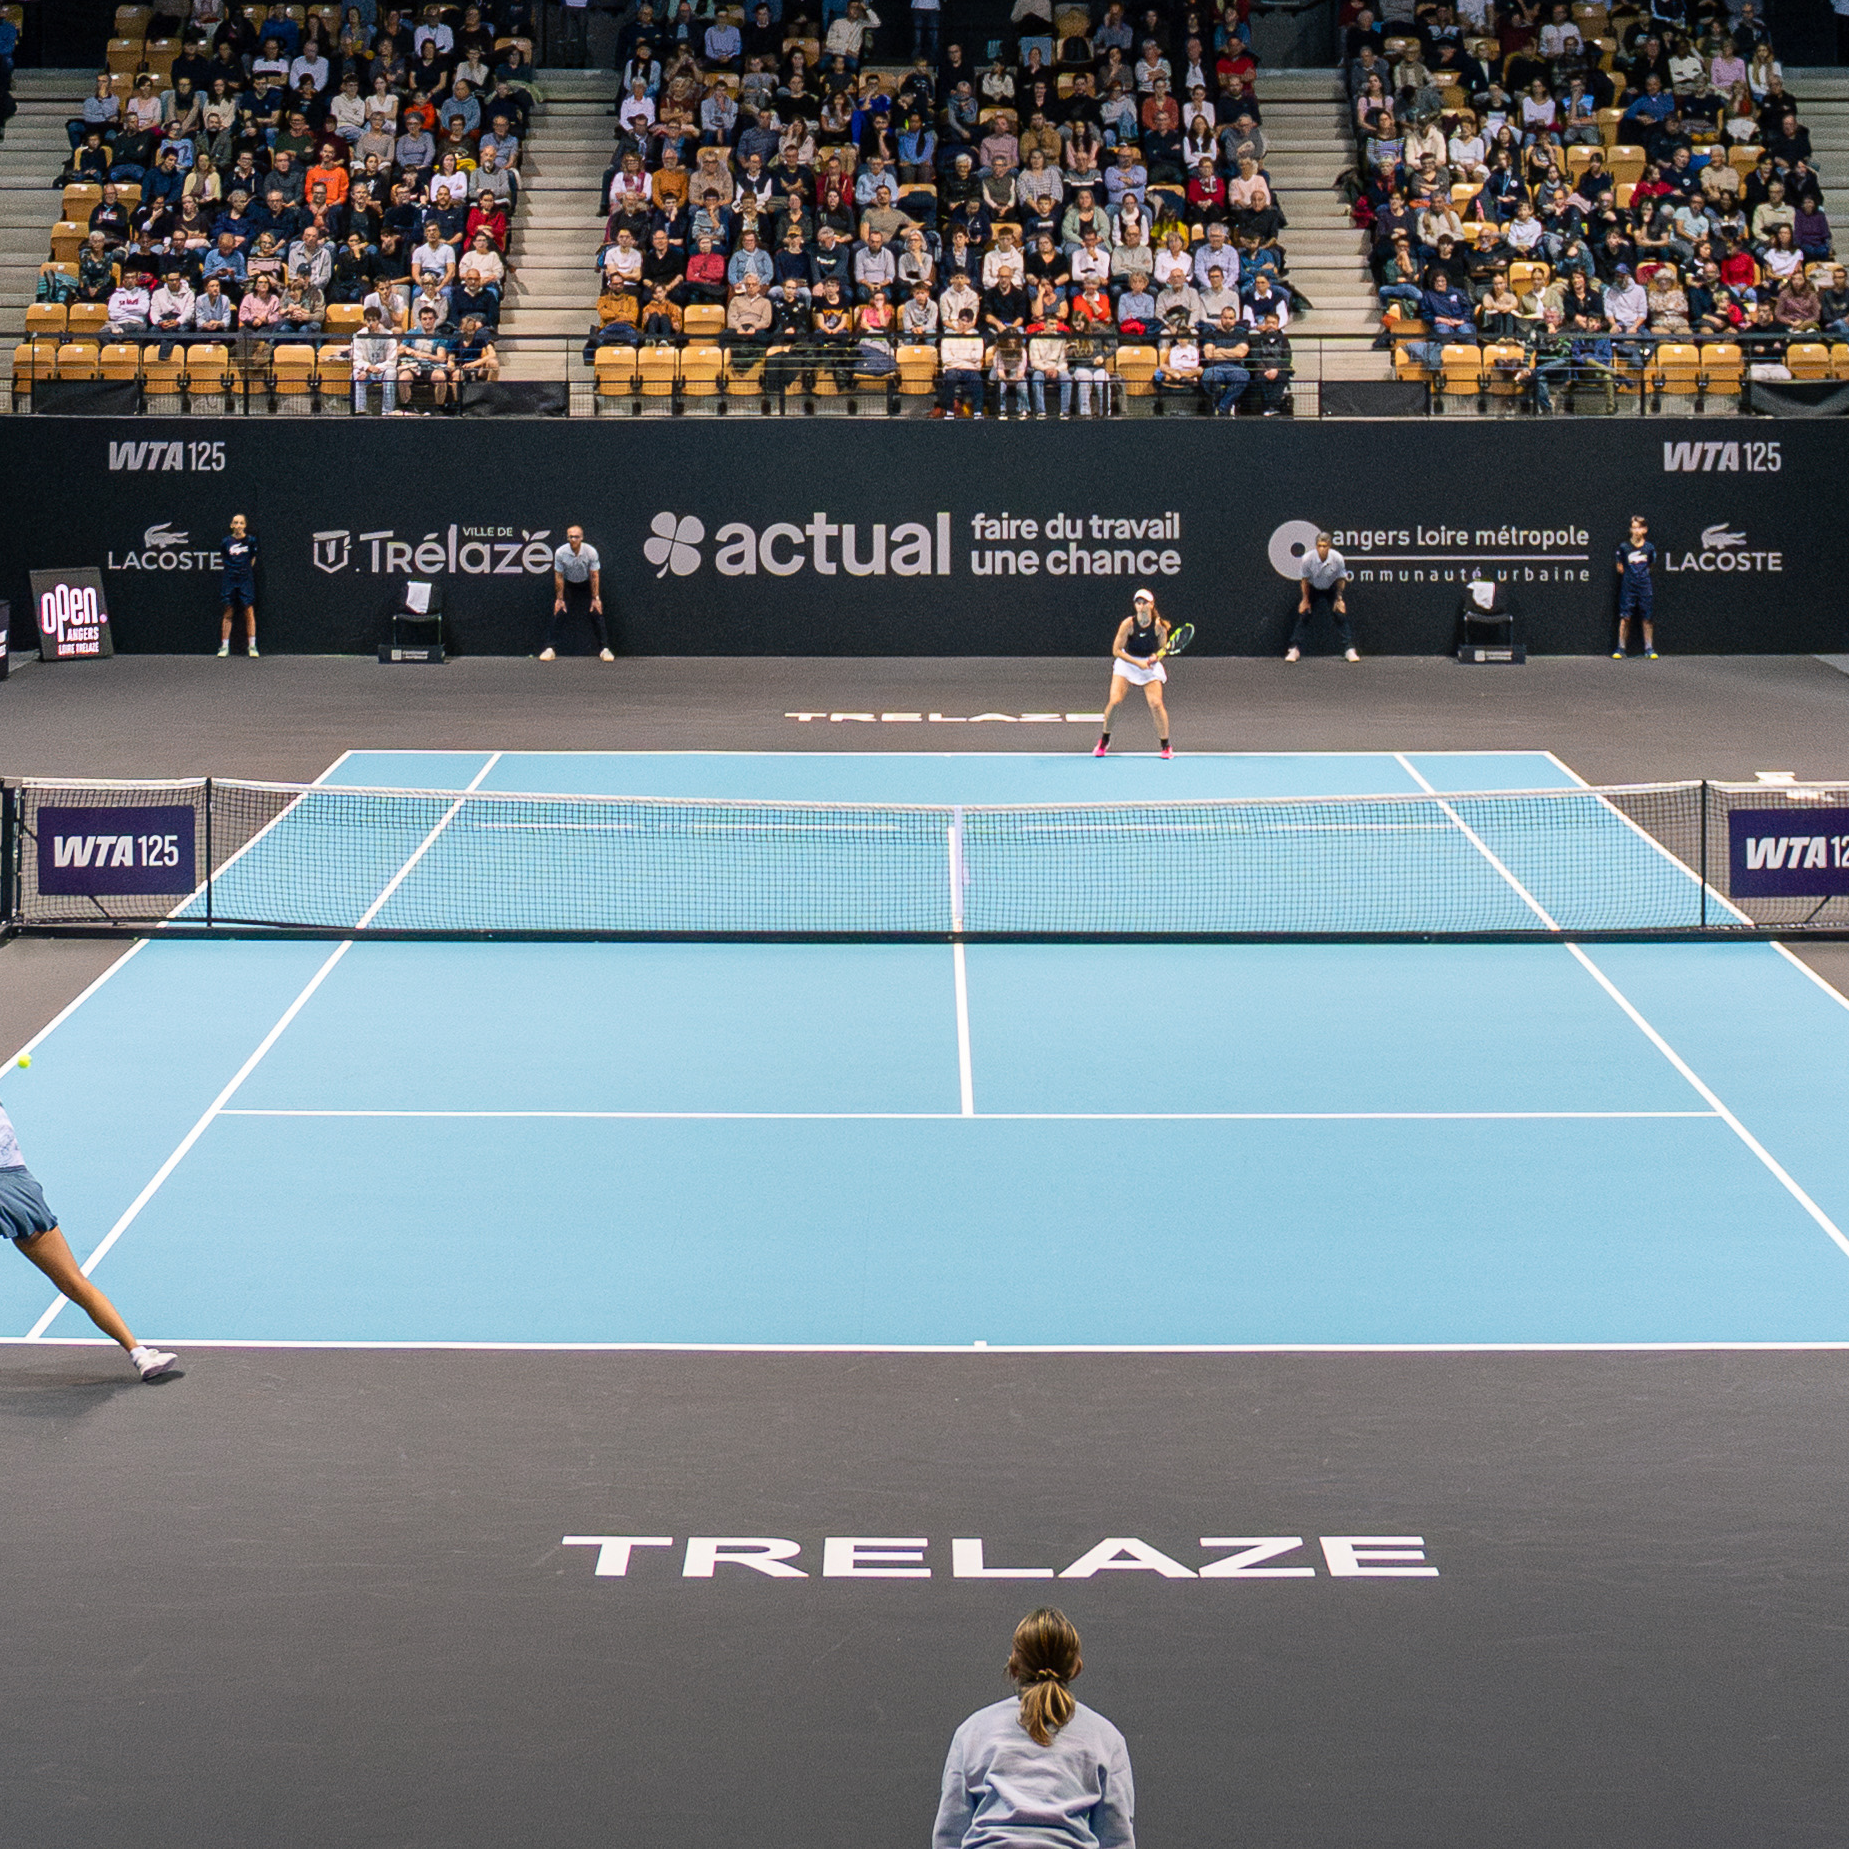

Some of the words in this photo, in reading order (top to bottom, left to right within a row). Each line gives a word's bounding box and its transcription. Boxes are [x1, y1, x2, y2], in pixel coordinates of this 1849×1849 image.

[108, 441, 184, 471] WTA
[189, 441, 226, 471] 125
[1663, 441, 1739, 472] WTA
[1744, 441, 1782, 472] 125
[462, 526, 492, 538] VILLE
[495, 526, 514, 537] DE
[971, 512, 1039, 540] faire
[1045, 512, 1083, 540] du
[1088, 512, 1181, 540] travail
[1332, 529, 1411, 550] angers
[1417, 526, 1469, 547] loire
[1474, 524, 1590, 550] métropole
[714, 512, 951, 576] actual
[108, 551, 224, 571] LACOSTE
[971, 550, 1041, 575] une
[1045, 542, 1182, 576] chance
[1665, 552, 1783, 572] LACOSTE
[1343, 566, 1483, 582] ommunauté
[1497, 566, 1590, 582] urbaine
[66, 626, 100, 642] ANGERS
[784, 712, 1106, 722] TRELAZE
[53, 835, 134, 868] WTA
[137, 834, 180, 868] 125
[1746, 836, 1828, 870] WTA
[561, 1535, 1440, 1579] TRELAZE
